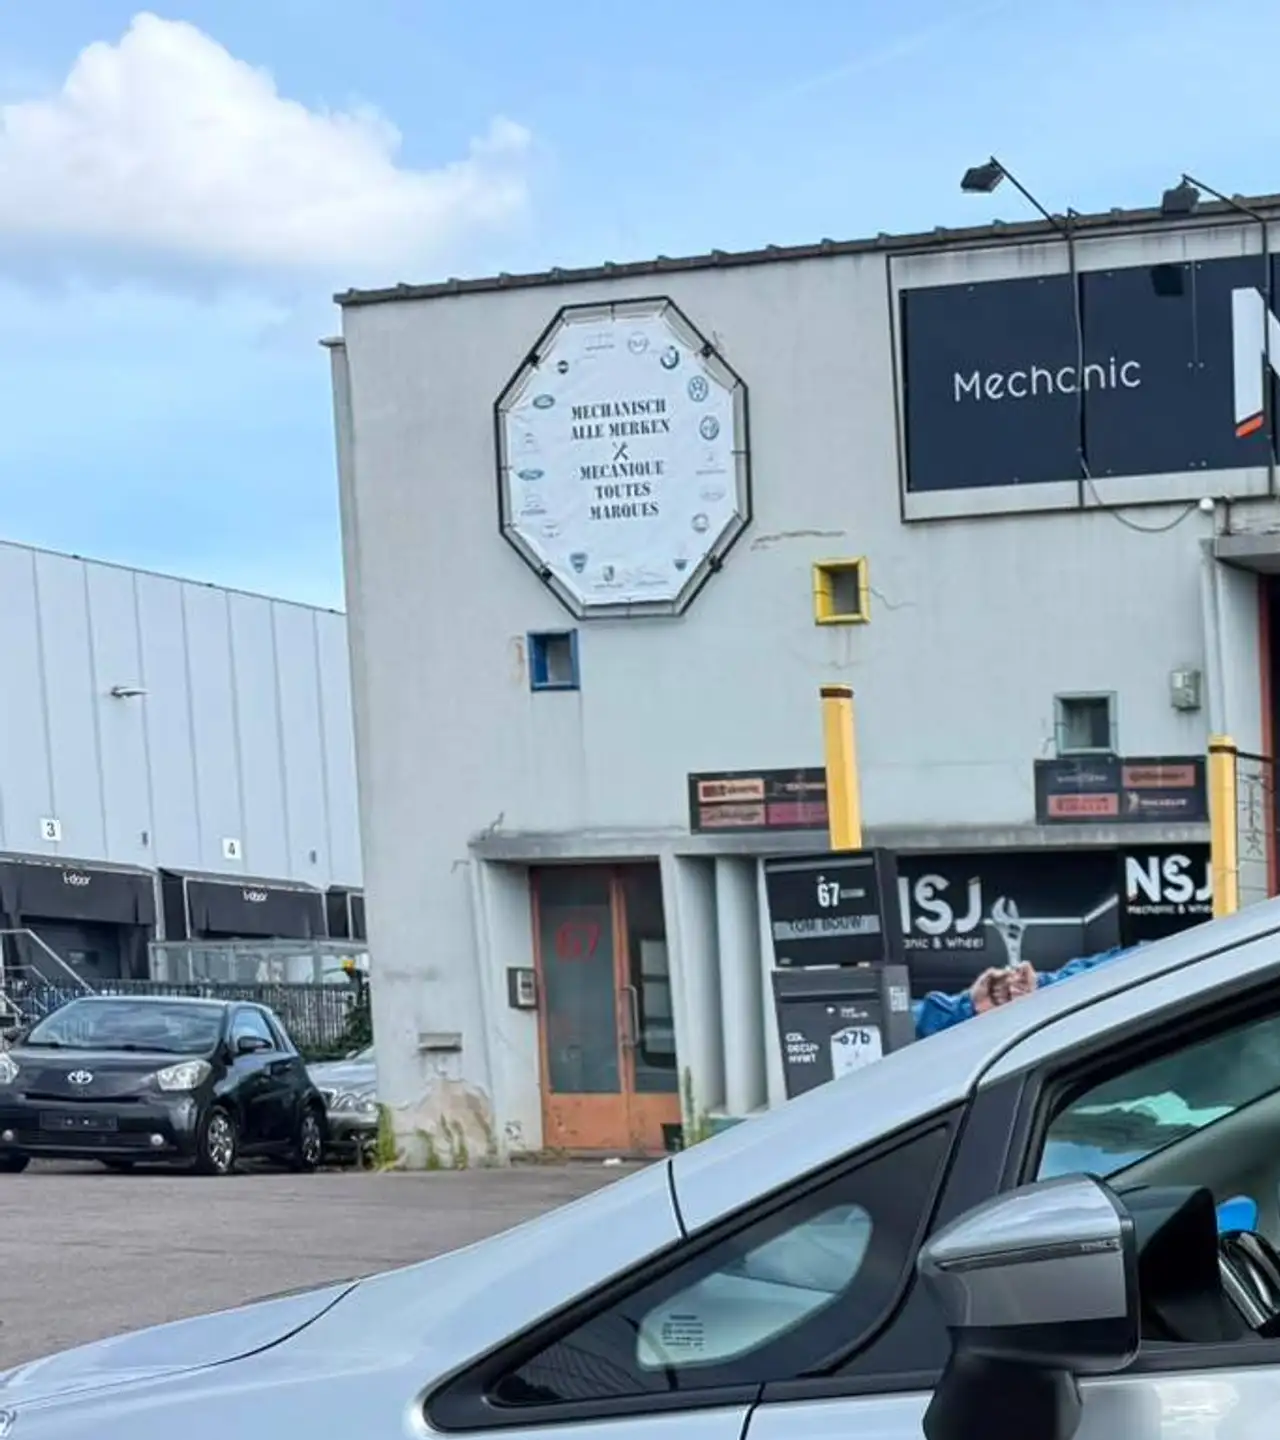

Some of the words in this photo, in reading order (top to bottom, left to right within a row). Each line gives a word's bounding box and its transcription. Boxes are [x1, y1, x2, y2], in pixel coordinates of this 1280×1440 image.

[571, 398, 666, 420] MECHANISCH
[571, 423, 604, 440] ALLE
[608, 418, 670, 437] MERKEN
[580, 459, 663, 480] MECANIQUE
[593, 482, 651, 499] TOUTES
[588, 502, 659, 520] MARQUES
[46, 822, 56, 838] 3
[817, 882, 839, 908] 67
